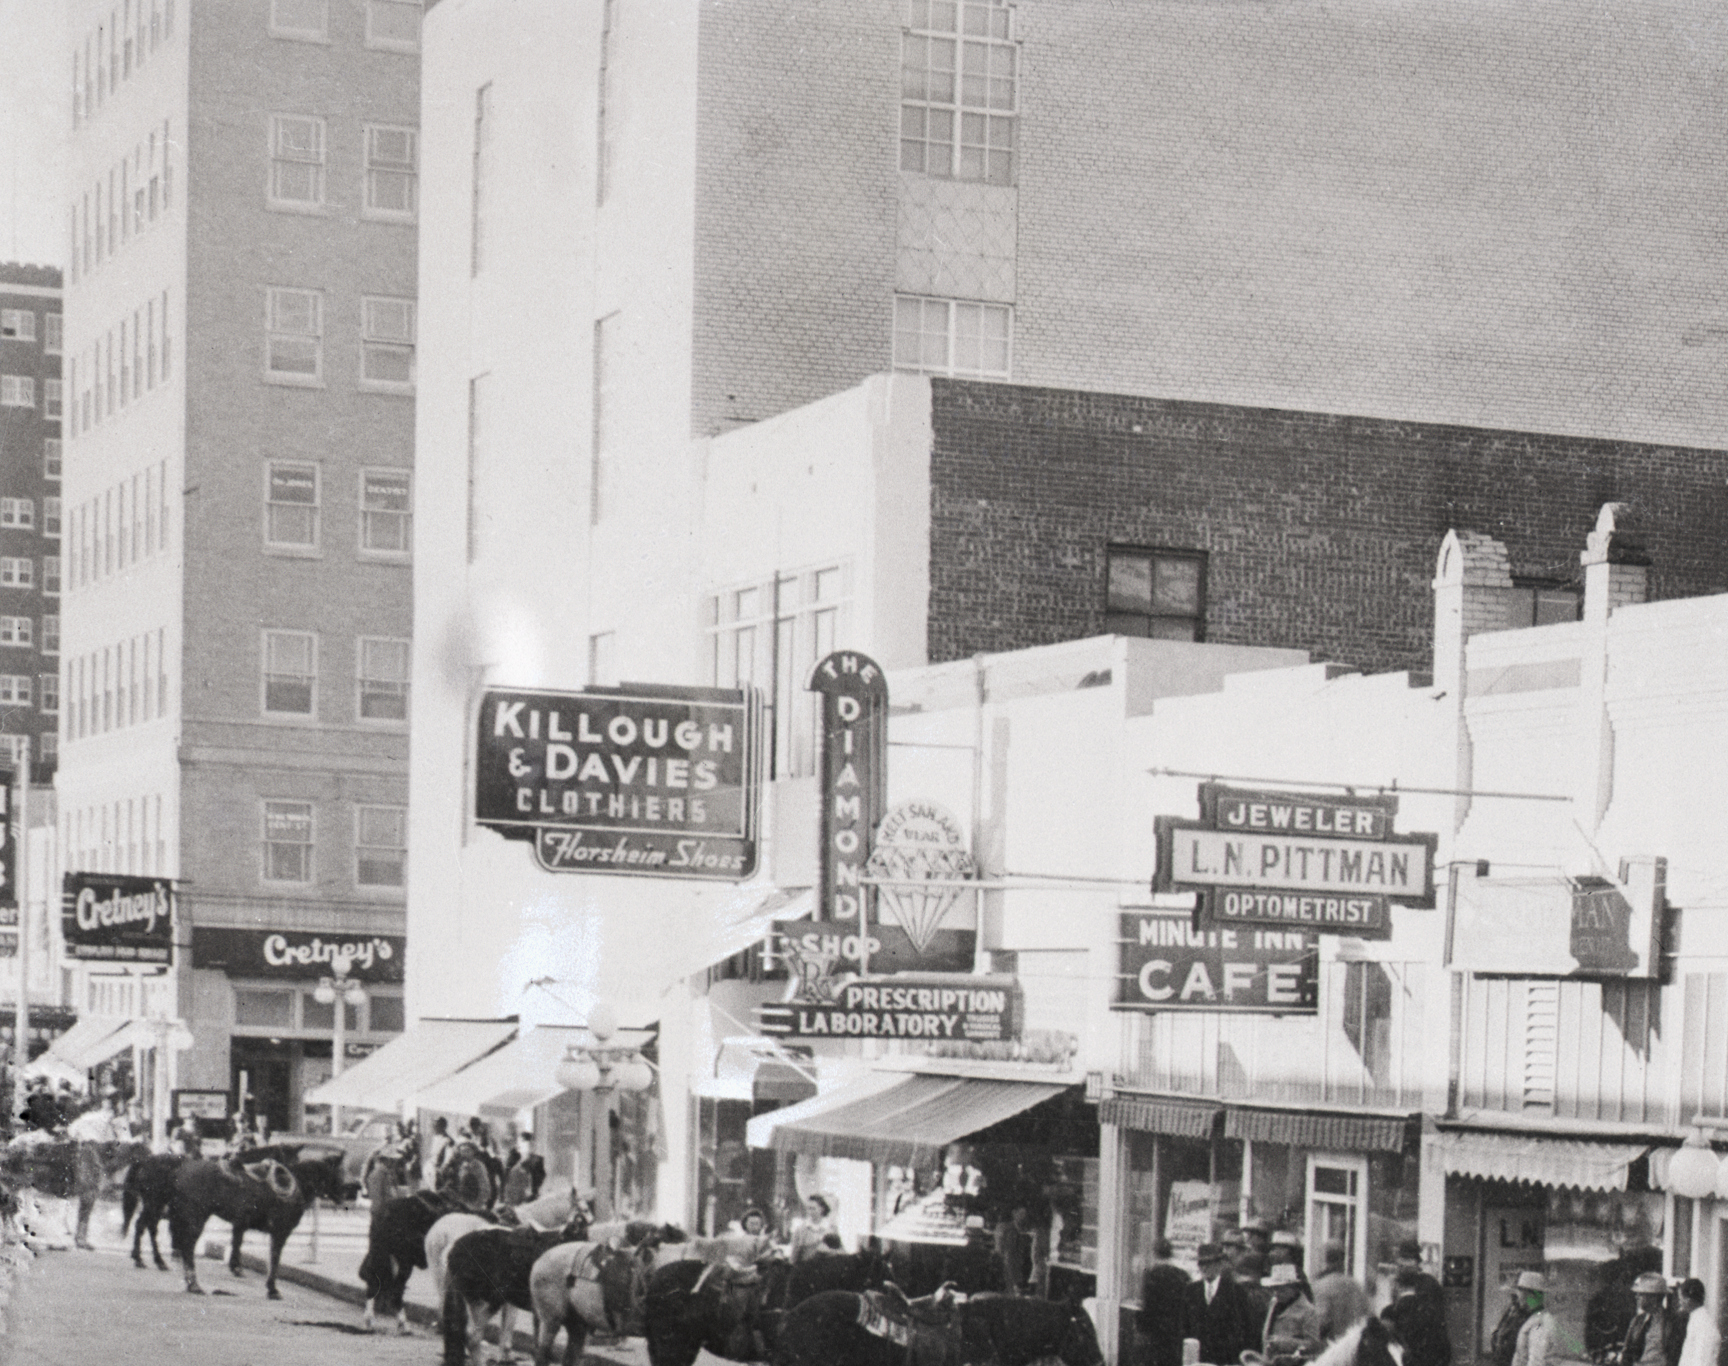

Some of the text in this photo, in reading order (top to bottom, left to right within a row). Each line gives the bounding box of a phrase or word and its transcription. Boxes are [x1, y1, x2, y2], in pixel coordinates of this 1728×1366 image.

[821, 656, 878, 685] THE
[494, 701, 732, 753] KILLOUGH
[508, 744, 718, 790] & DAVIES
[516, 787, 707, 824] CLOTHIERS
[834, 696, 861, 920] DIAMOND
[1228, 803, 1374, 834] JEWELER
[544, 831, 747, 870] Florsheim Shoes
[1259, 844, 1409, 887] PITTMAN
[77, 881, 169, 933] Cretney's
[1224, 893, 1372, 923] OPTOMETRIST
[263, 934, 393, 969] Cretney's
[801, 933, 881, 961] SHOP
[846, 986, 1006, 1013] PRESCRIPTION
[799, 1011, 959, 1037] LABORATORY
